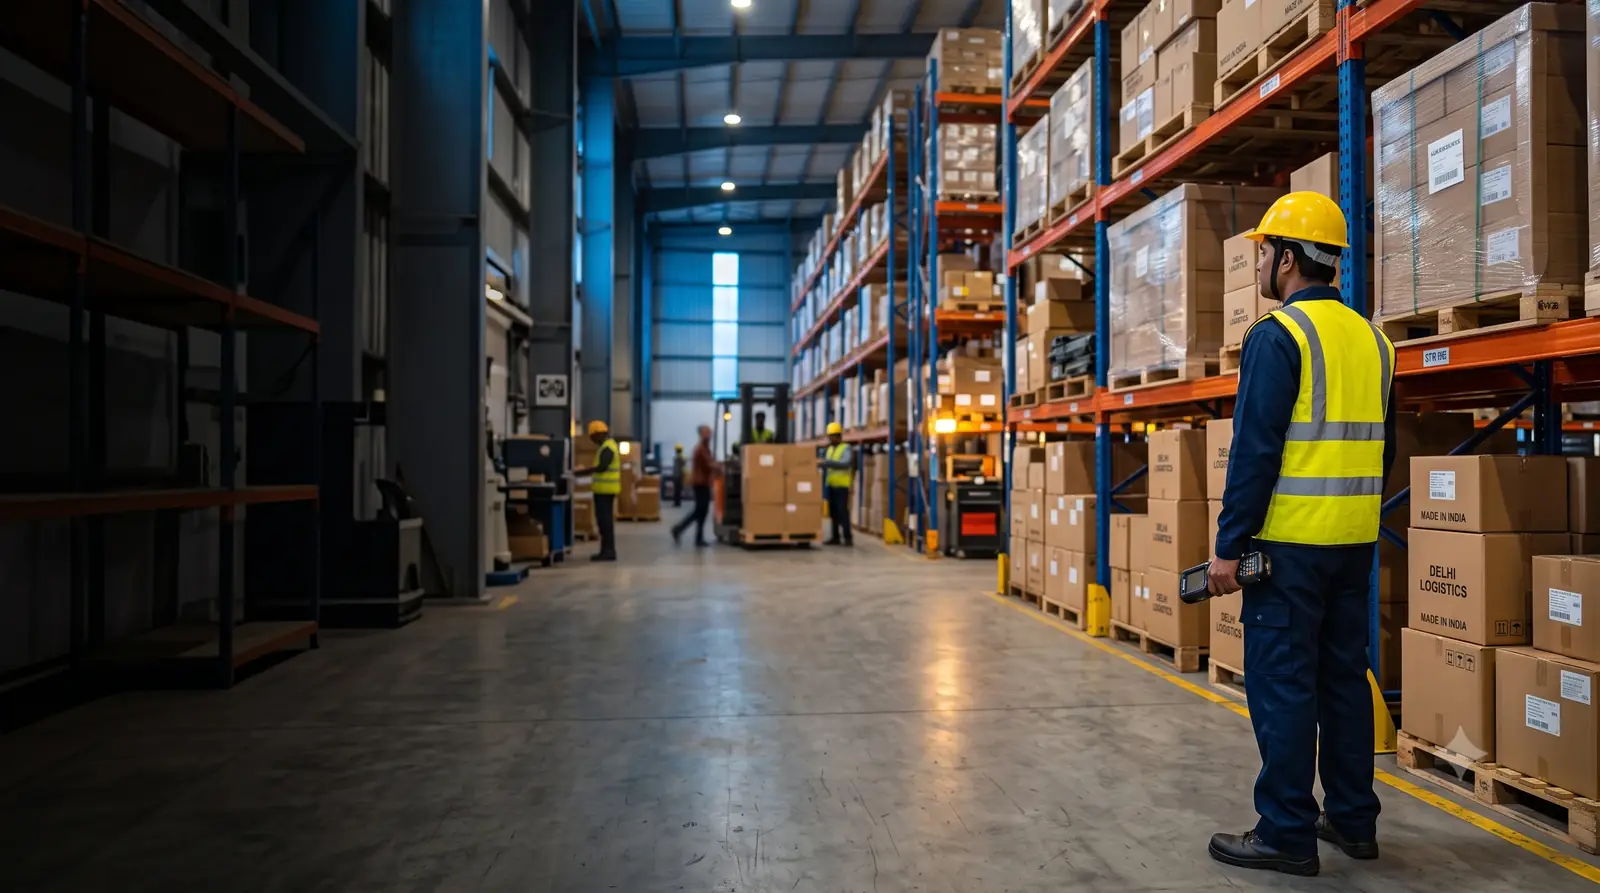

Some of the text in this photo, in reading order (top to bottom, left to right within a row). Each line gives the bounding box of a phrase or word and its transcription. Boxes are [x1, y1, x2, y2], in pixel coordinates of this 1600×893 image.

[1213, 460, 1228, 469] LOGIS
[1421, 511, 1466, 523] MADE IN INDIA
[1430, 565, 1456, 580] DELHI
[1420, 579, 1467, 598] LOGISTICS
[1221, 612, 1235, 625] DELHI
[1420, 613, 1467, 631] MADE IN INDIA
[1216, 622, 1242, 639] LOGISTICS
